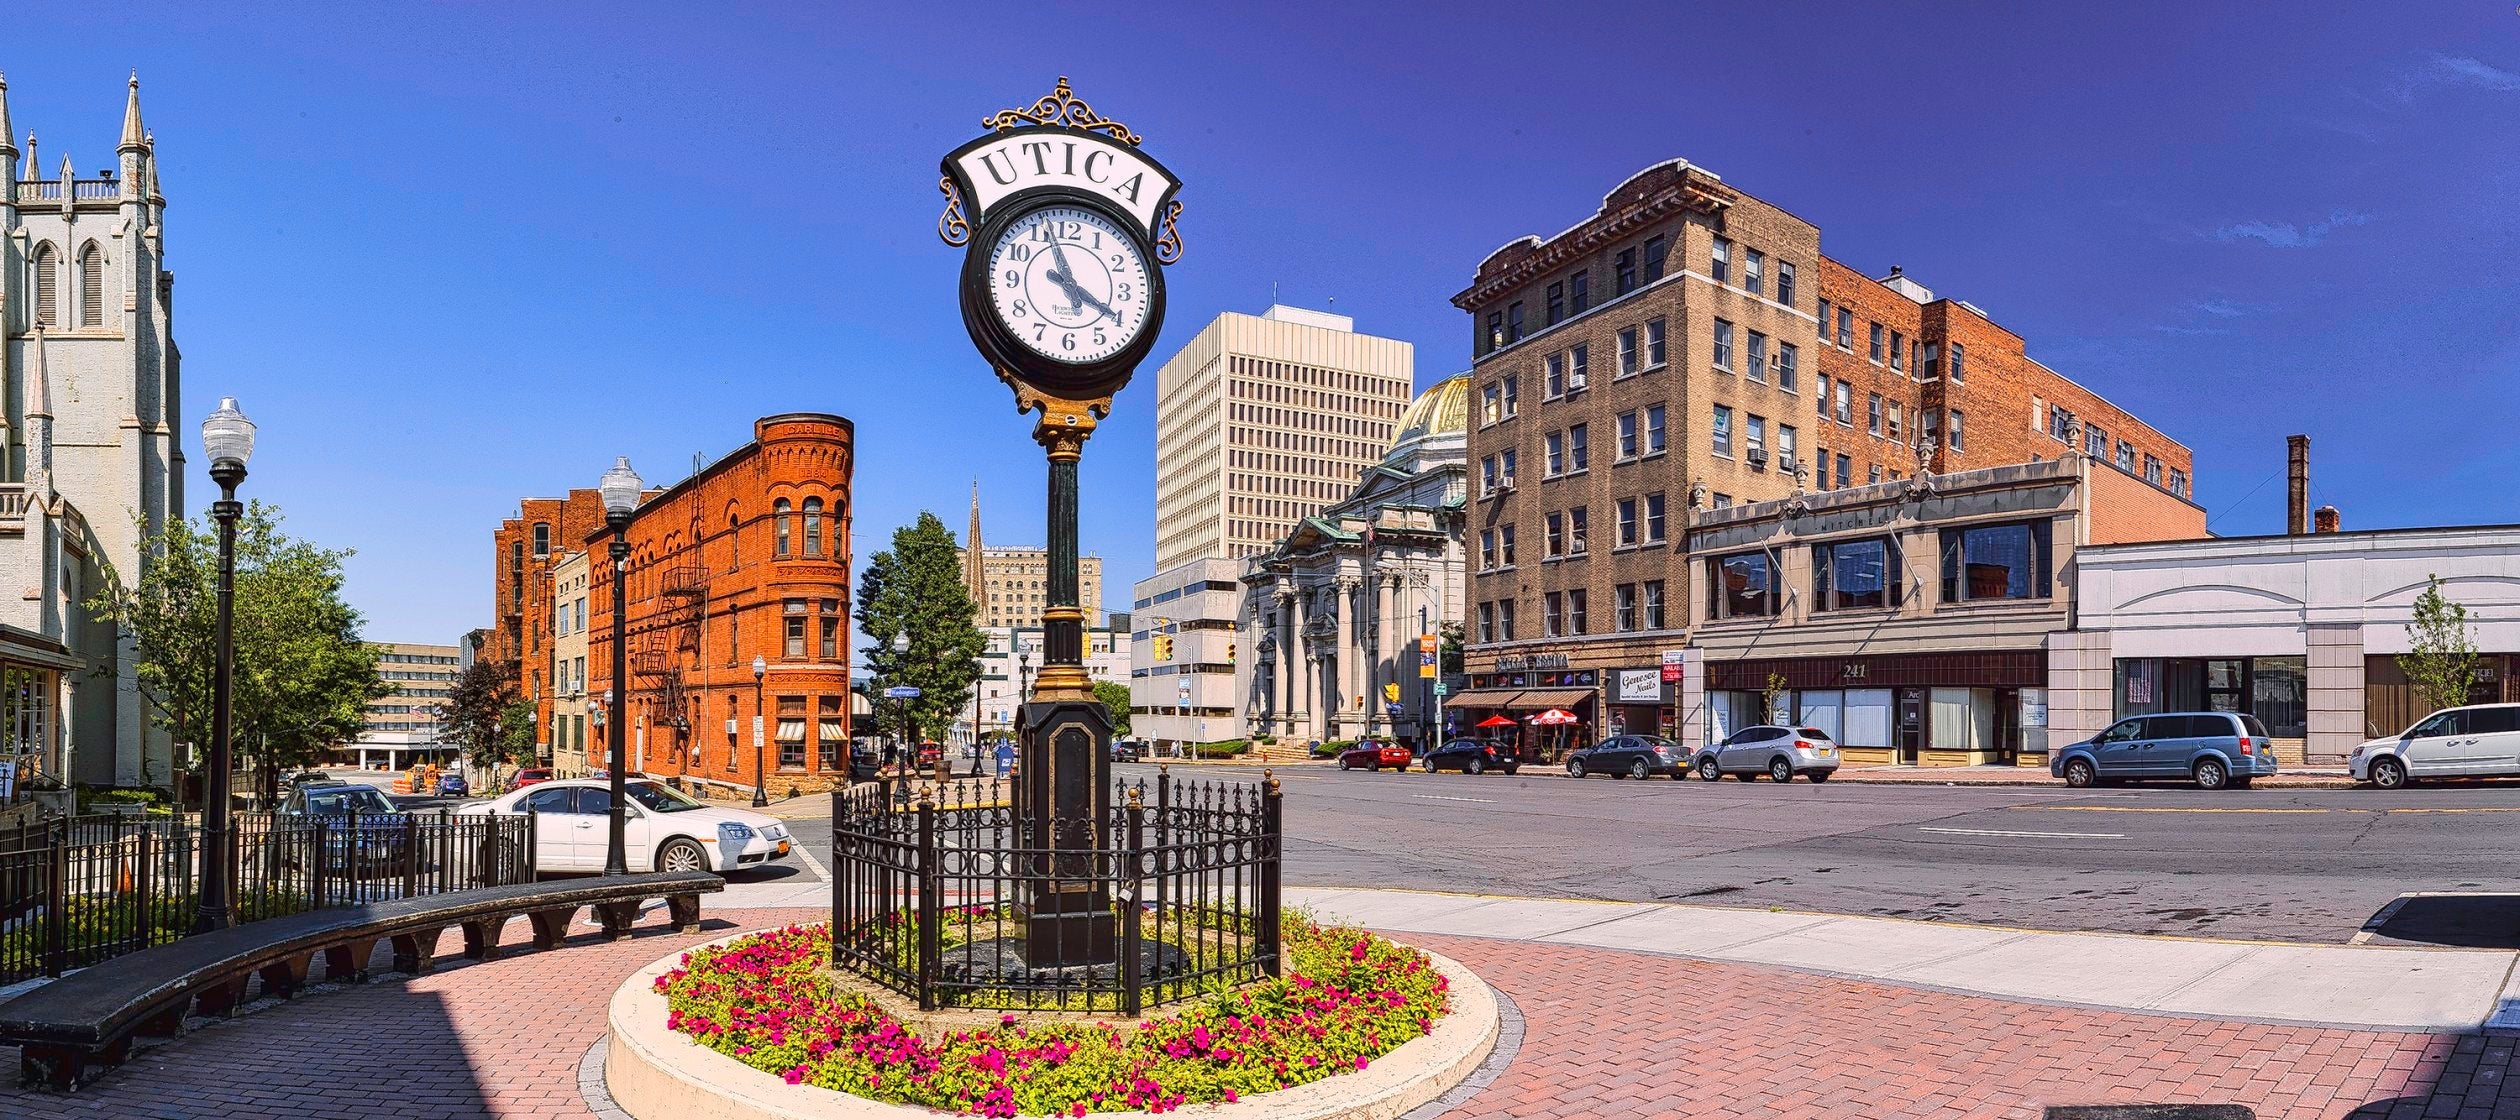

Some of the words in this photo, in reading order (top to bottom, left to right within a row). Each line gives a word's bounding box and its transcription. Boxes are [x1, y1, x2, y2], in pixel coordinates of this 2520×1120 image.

[978, 141, 1144, 207] UTICA
[1057, 221, 1082, 241] 12
[1091, 231, 1102, 250] 1
[1007, 243, 1030, 262] 10
[1111, 254, 1125, 272] 2
[1005, 270, 1019, 288] 9
[1117, 283, 1131, 302] 3
[1013, 299, 1026, 318] 8
[1112, 309, 1124, 328] 4
[1032, 322, 1047, 341] 7
[1094, 327, 1107, 346] 5
[1062, 333, 1075, 351] 6
[1622, 671, 1658, 689] Genesee
[1843, 664, 1866, 678] 241
[1635, 681, 1657, 694] Nails
